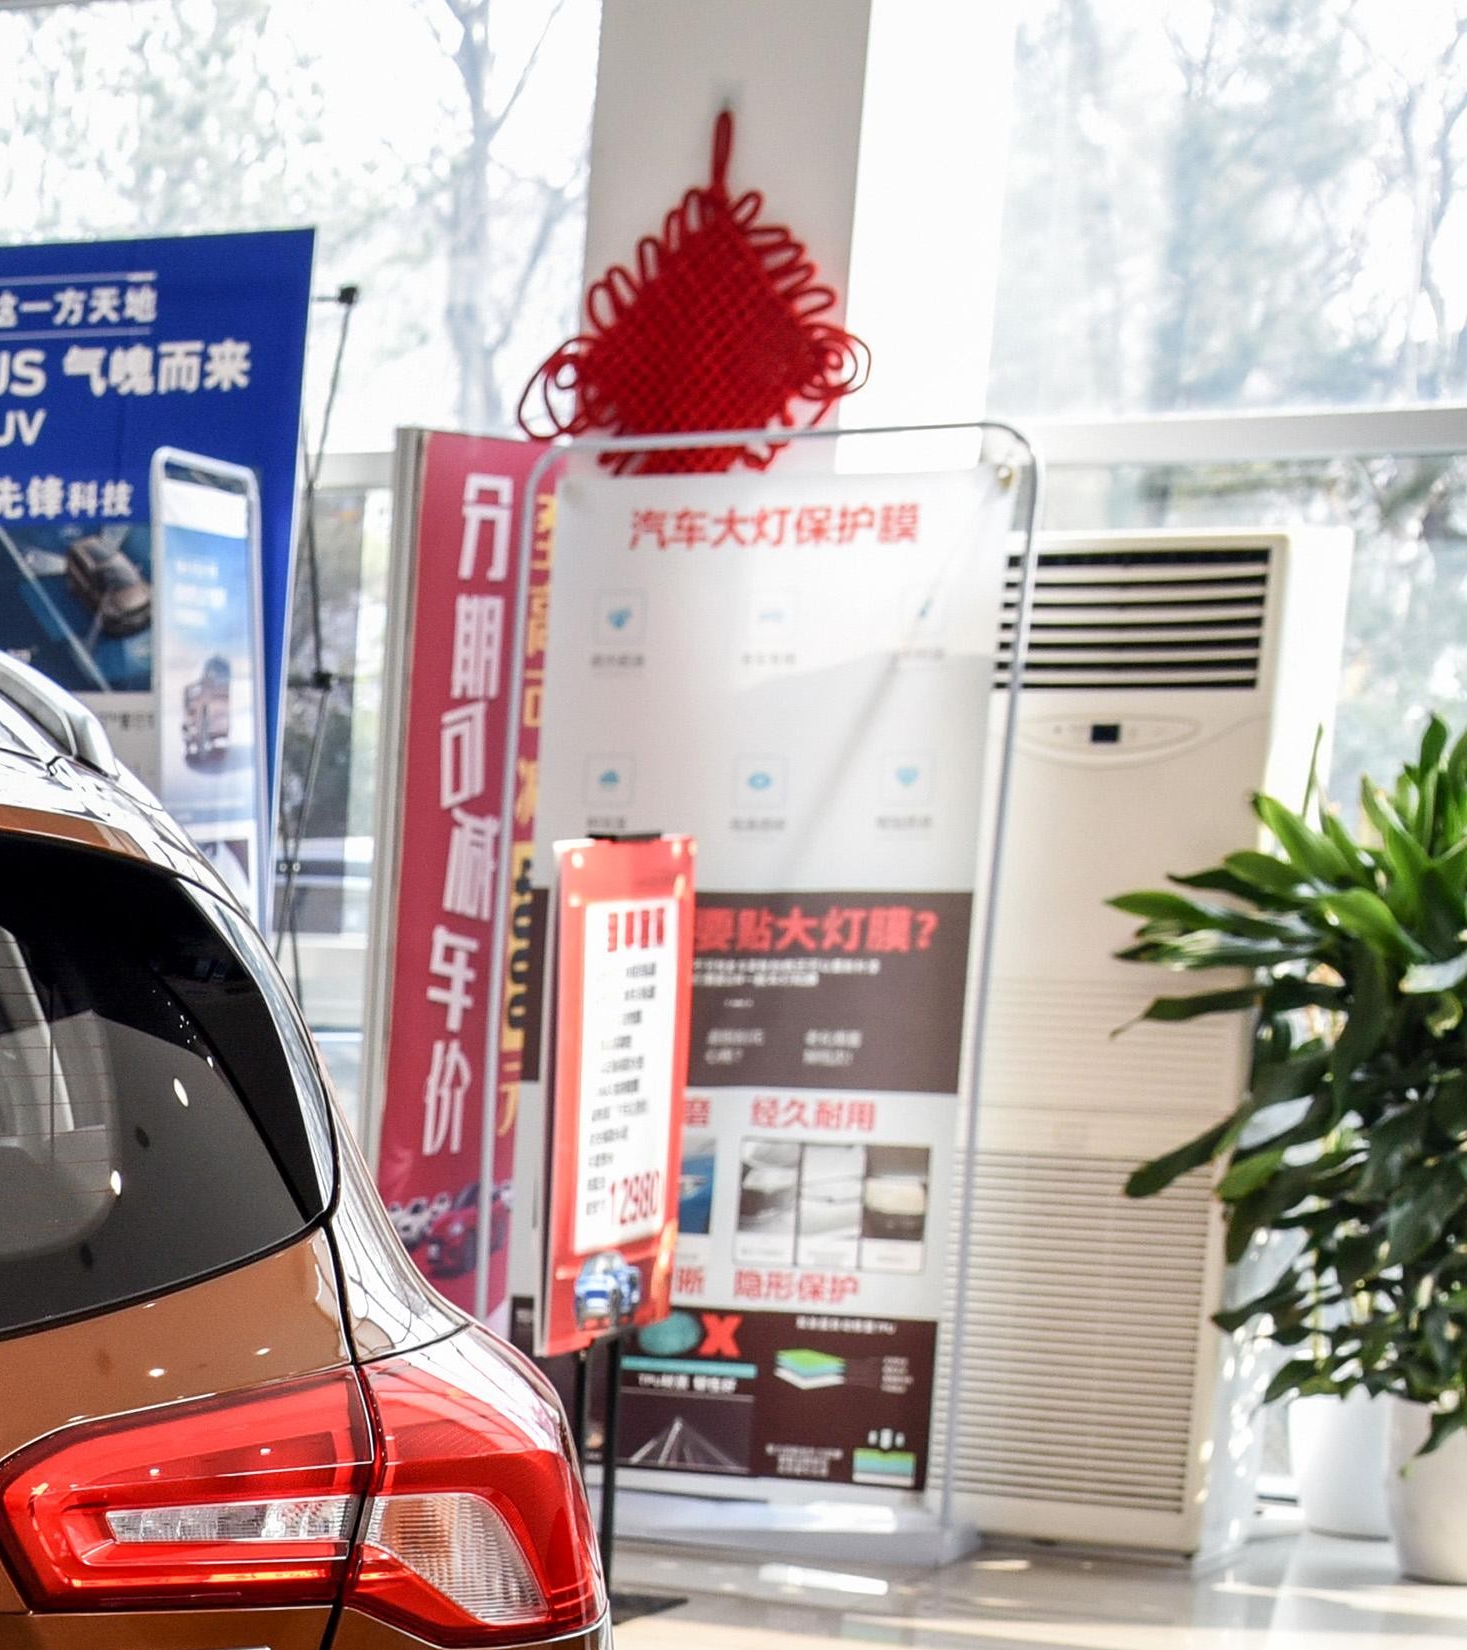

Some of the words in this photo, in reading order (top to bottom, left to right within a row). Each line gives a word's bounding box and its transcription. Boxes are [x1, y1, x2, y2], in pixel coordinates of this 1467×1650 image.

[629, 503, 920, 552] 汽车大灯保护膜
[750, 1095, 878, 1132] 经久耐用
[733, 1268, 860, 1303] 隐形保护
